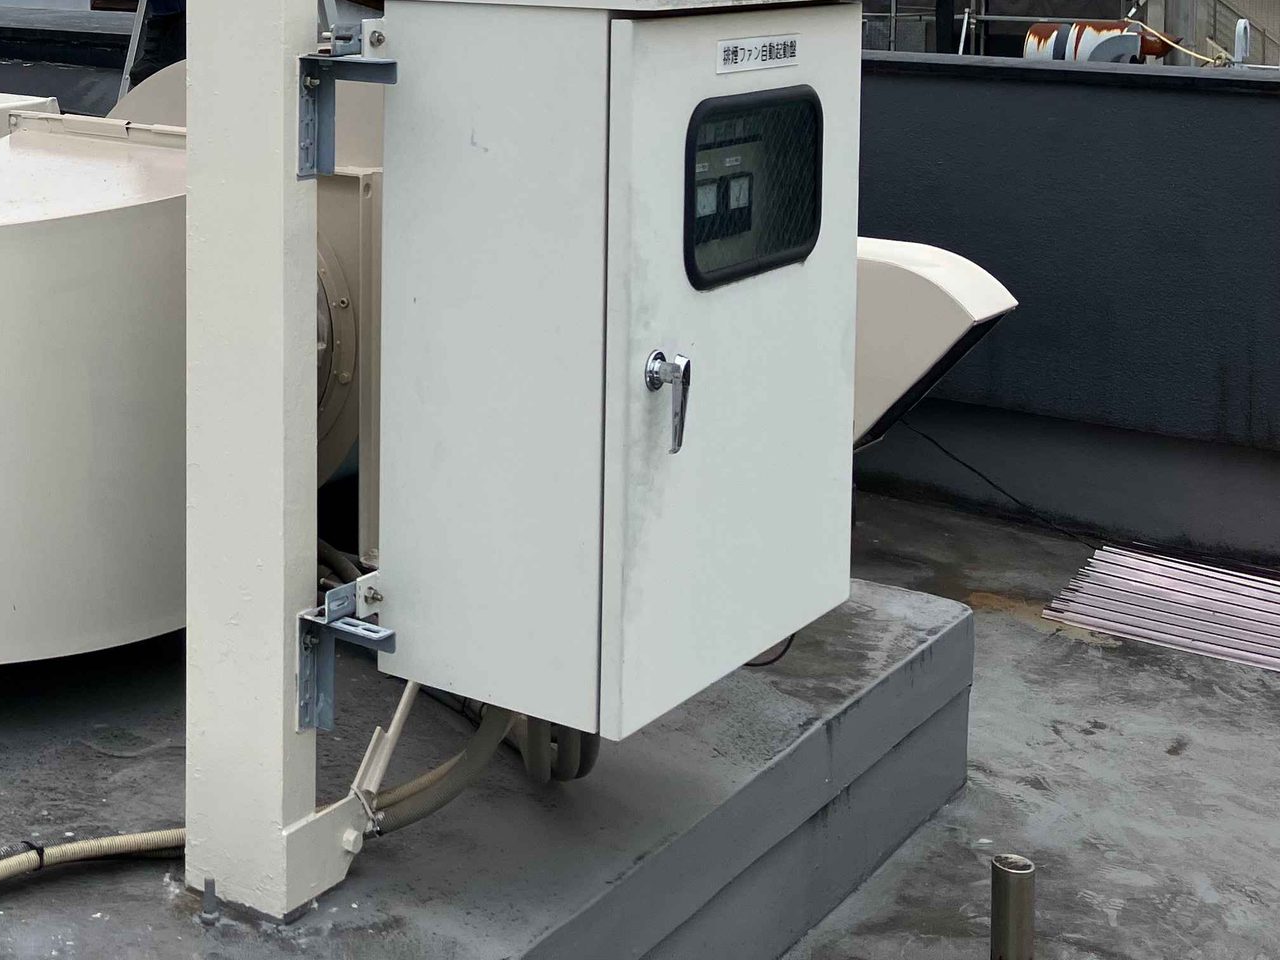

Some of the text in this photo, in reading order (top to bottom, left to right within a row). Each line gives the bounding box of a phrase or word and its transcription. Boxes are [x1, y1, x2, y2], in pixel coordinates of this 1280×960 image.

[723, 40, 797, 65] 排煙ファン自動起動盤
